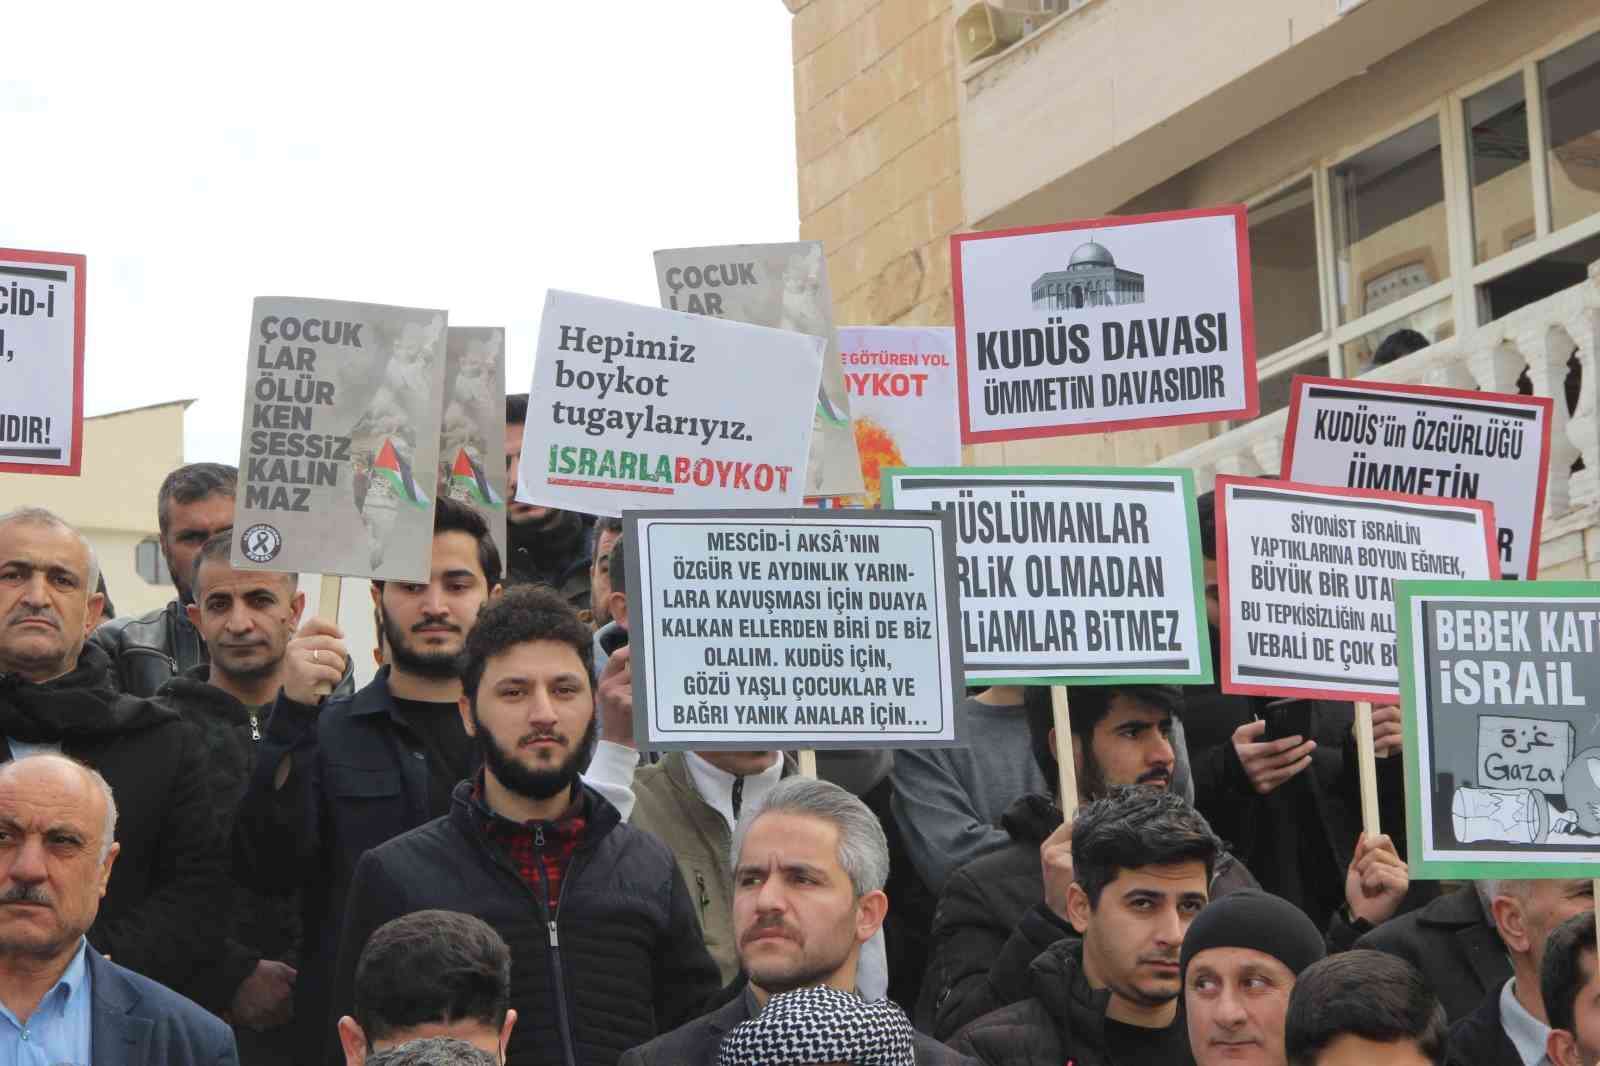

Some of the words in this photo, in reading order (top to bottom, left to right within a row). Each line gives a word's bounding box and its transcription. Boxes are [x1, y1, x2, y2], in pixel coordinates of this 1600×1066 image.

[665, 262, 758, 294] ÇOCUK
[260, 316, 364, 348] ÇOCUK
[558, 325, 696, 363] Hepimiz
[976, 317, 1091, 371] KUDÜS
[1102, 312, 1228, 361] DAVASI
[257, 345, 317, 372] LAR
[850, 351, 918, 366] GÖTÜREN
[922, 354, 949, 367] YOL
[255, 372, 335, 405] ÖLÜR
[555, 360, 669, 399] boykot
[844, 373, 928, 397] YKOT
[1102, 365, 1225, 407] DAVASIDIR
[252, 404, 312, 431] KEN
[552, 401, 753, 445] tugaylarıyız.
[1412, 410, 1524, 460] ÖZGÜRLÜĞÜ
[247, 458, 338, 487] KALIN
[244, 485, 311, 512] MAZ
[1291, 510, 1356, 538] SİYONİST
[707, 528, 790, 552] MESCİD-İ
[673, 556, 733, 580] ÖZGÜR
[738, 561, 762, 581] VE
[768, 561, 848, 582] AYDINLIK
[856, 563, 915, 582] YARIN-
[1251, 536, 1353, 566] YAPTIKLARINA
[1358, 547, 1407, 571] BOYUN
[1412, 549, 1465, 579] EĞMEK,
[1025, 556, 1165, 598] OLMADAN
[1251, 561, 1312, 595] BÜYÜK
[1319, 568, 1349, 598] BİR
[1355, 575, 1395, 602] UTA
[663, 589, 710, 609] LARA
[716, 590, 821, 614] KAVUŞMASI
[827, 587, 863, 615] İÇİN
[869, 591, 927, 611] DUAYA
[662, 619, 733, 637] KALKAN
[739, 619, 828, 638] ELLERDEN
[834, 615, 870, 639] BİRİ
[876, 620, 898, 639] DE
[904, 616, 931, 640] BİZ
[1241, 601, 1260, 621] BU
[1265, 602, 1365, 631] TEPKİSİZLİĞİN
[1435, 610, 1531, 652] BEBEK
[704, 647, 778, 667] OLALIM.
[785, 643, 844, 667] KUDÜS
[850, 644, 892, 671] İÇİN,
[1248, 632, 1307, 659] VEBALİ
[1312, 638, 1335, 662] DE
[1340, 640, 1375, 671] ÇOK
[684, 672, 730, 696] GÖZÜ
[736, 676, 786, 700] YAŞLI
[792, 677, 886, 701] ÇOCUKLAR
[893, 677, 915, 697] VE
[673, 701, 728, 725] BAĞRI
[735, 705, 788, 725] YANIK
[794, 705, 865, 726] ANALAR
[1501, 724, 1555, 753] غزة
[1485, 753, 1555, 782] Gaza
